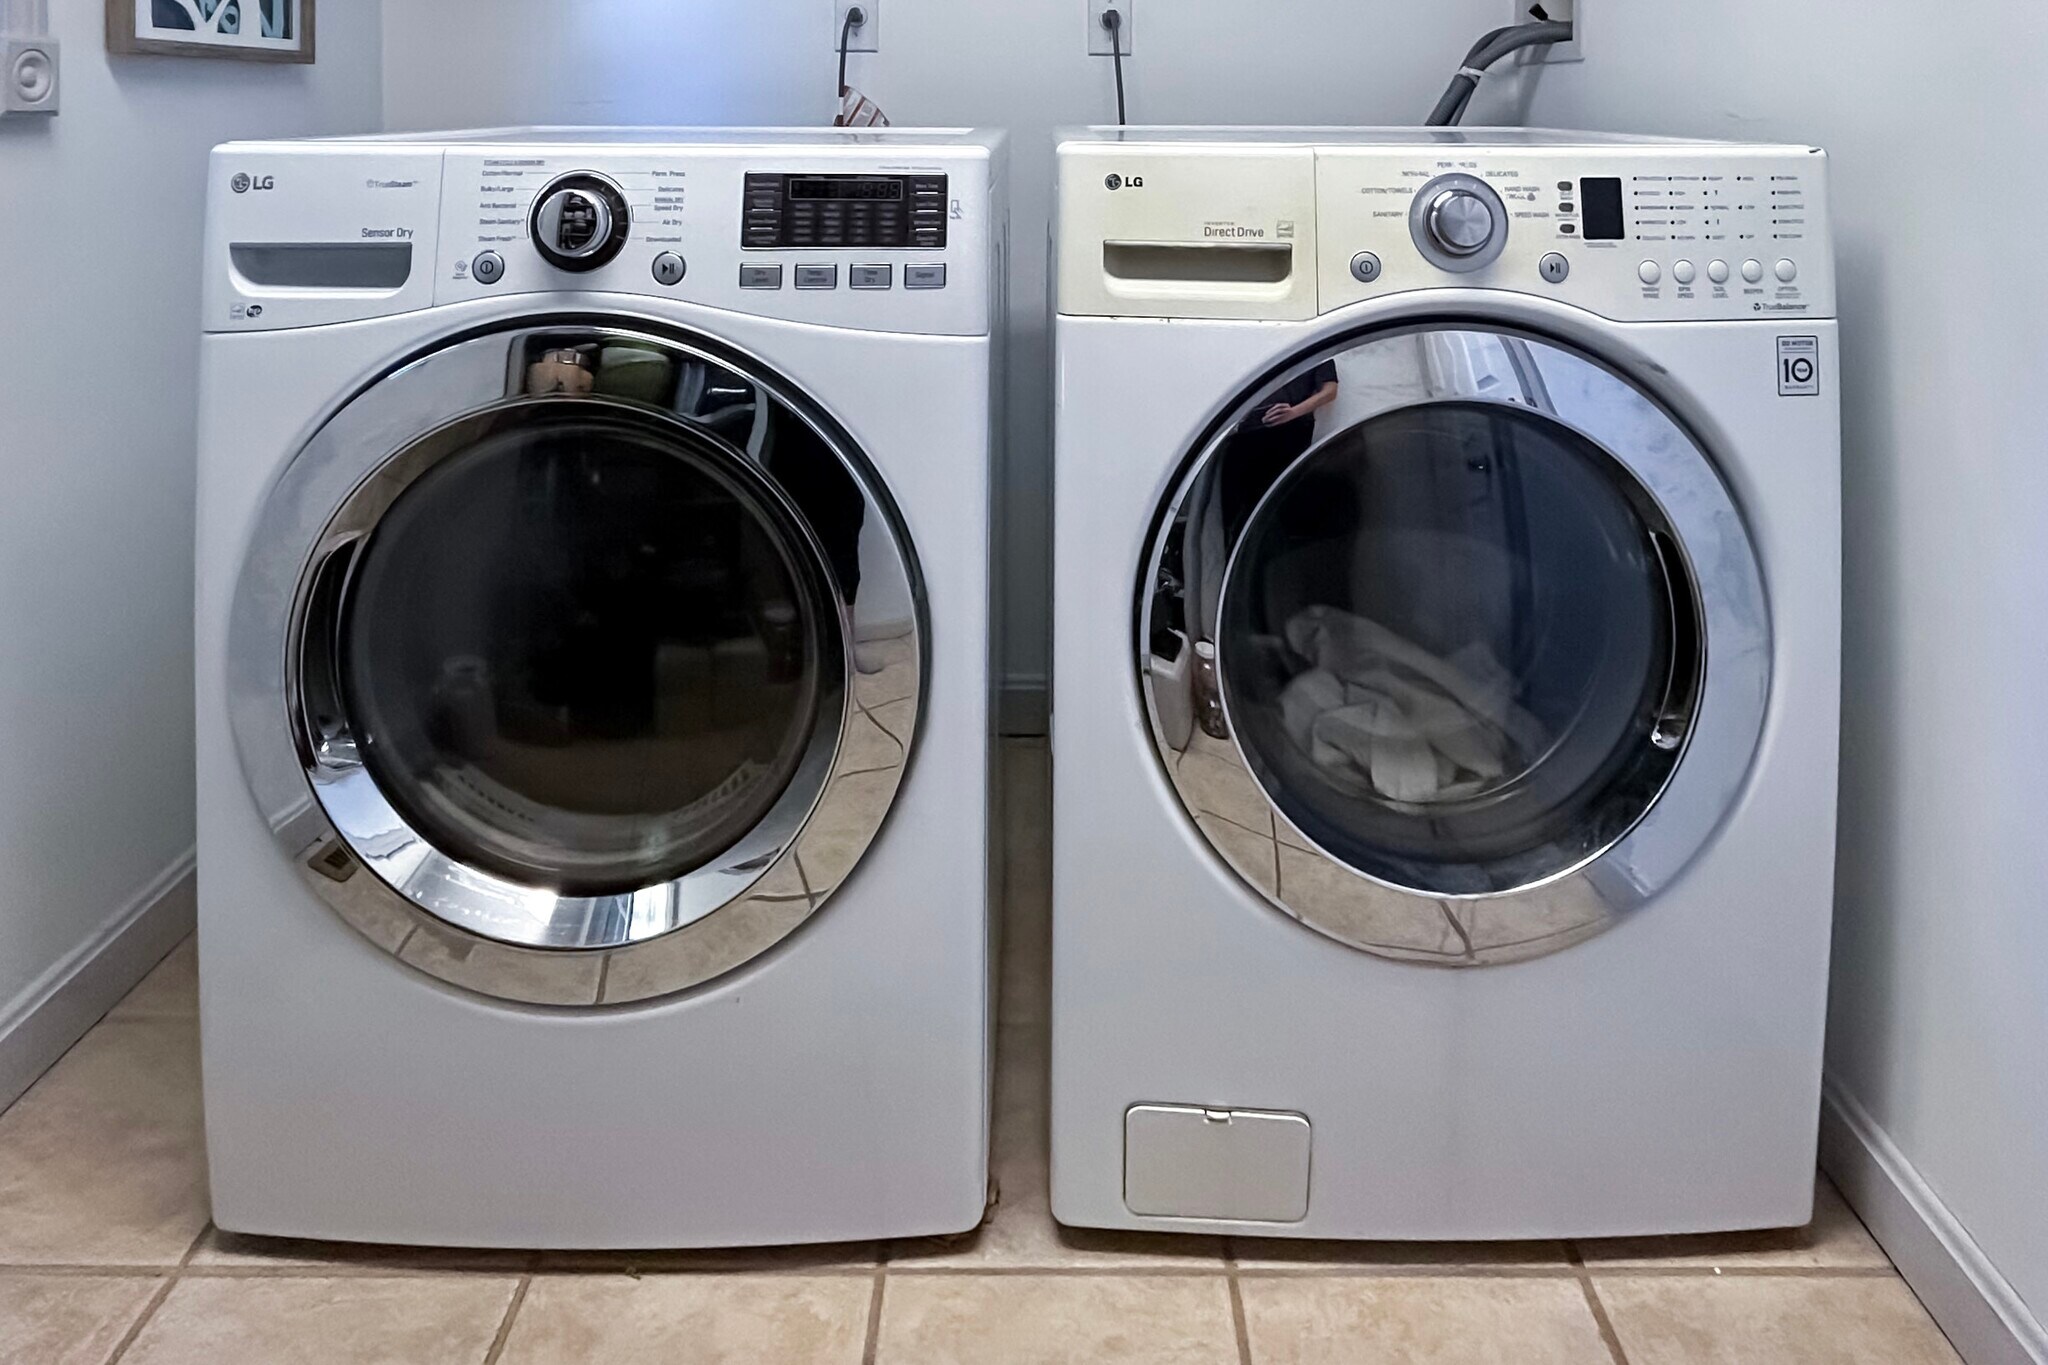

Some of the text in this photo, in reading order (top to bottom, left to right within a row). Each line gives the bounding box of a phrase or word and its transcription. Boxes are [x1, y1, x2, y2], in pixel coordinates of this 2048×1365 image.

[253, 175, 274, 190] LG
[1124, 176, 1143, 188] LG
[361, 227, 414, 239] Sensor Dry
[1204, 226, 1264, 238] Direct Drive
[1783, 357, 1813, 383] 10
